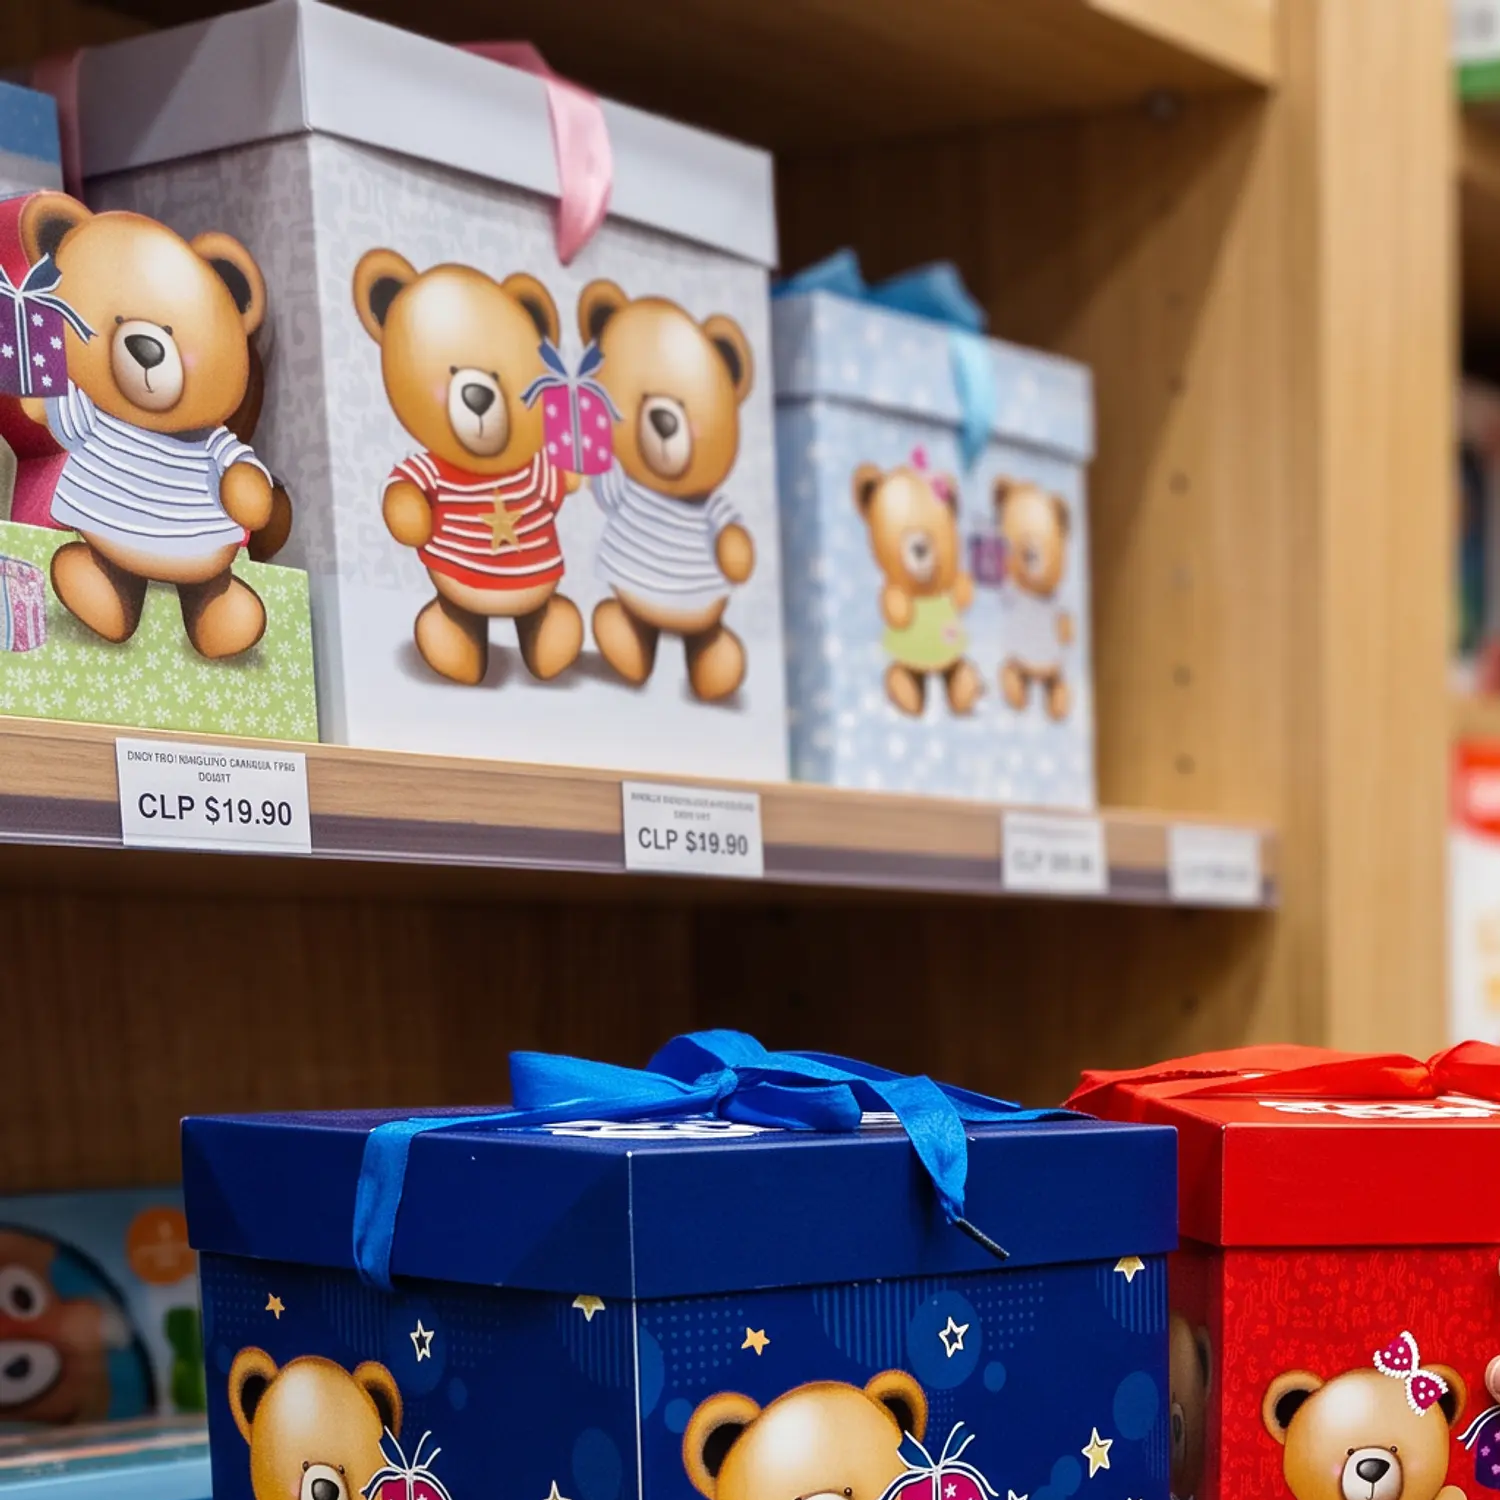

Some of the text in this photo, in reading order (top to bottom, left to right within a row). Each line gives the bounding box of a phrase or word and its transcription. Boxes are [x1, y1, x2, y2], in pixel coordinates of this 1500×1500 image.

[138, 793, 292, 826] CLP $19.90
[638, 827, 748, 856] CLP $19.90
